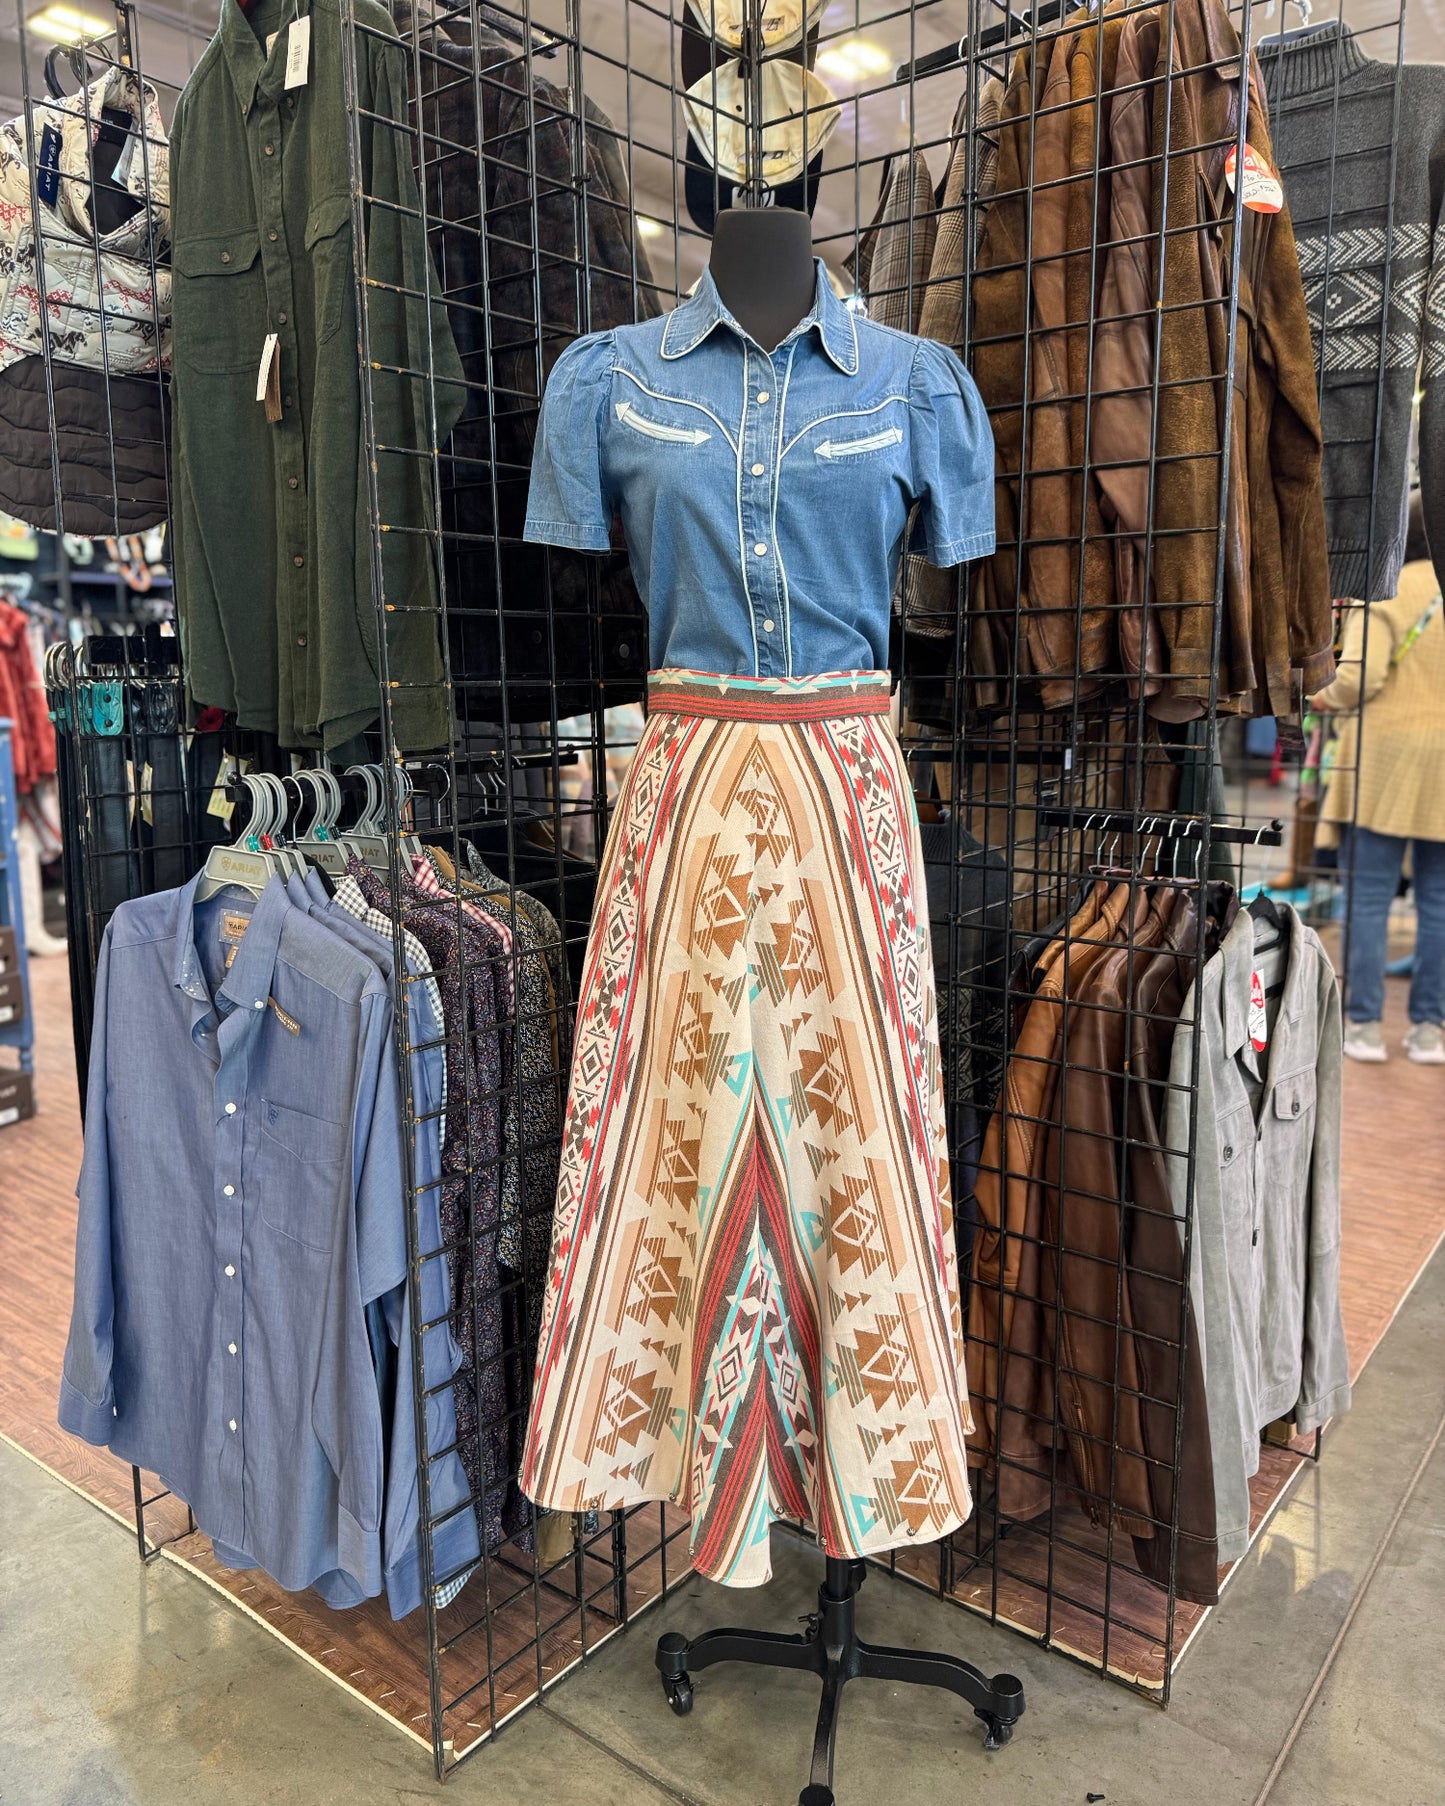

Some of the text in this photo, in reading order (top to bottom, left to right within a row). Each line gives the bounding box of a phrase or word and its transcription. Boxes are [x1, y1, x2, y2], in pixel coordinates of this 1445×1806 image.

[359, 847, 379, 857] RIAT
[311, 853, 335, 863] RIAT
[231, 862, 262, 874] ARIAT
